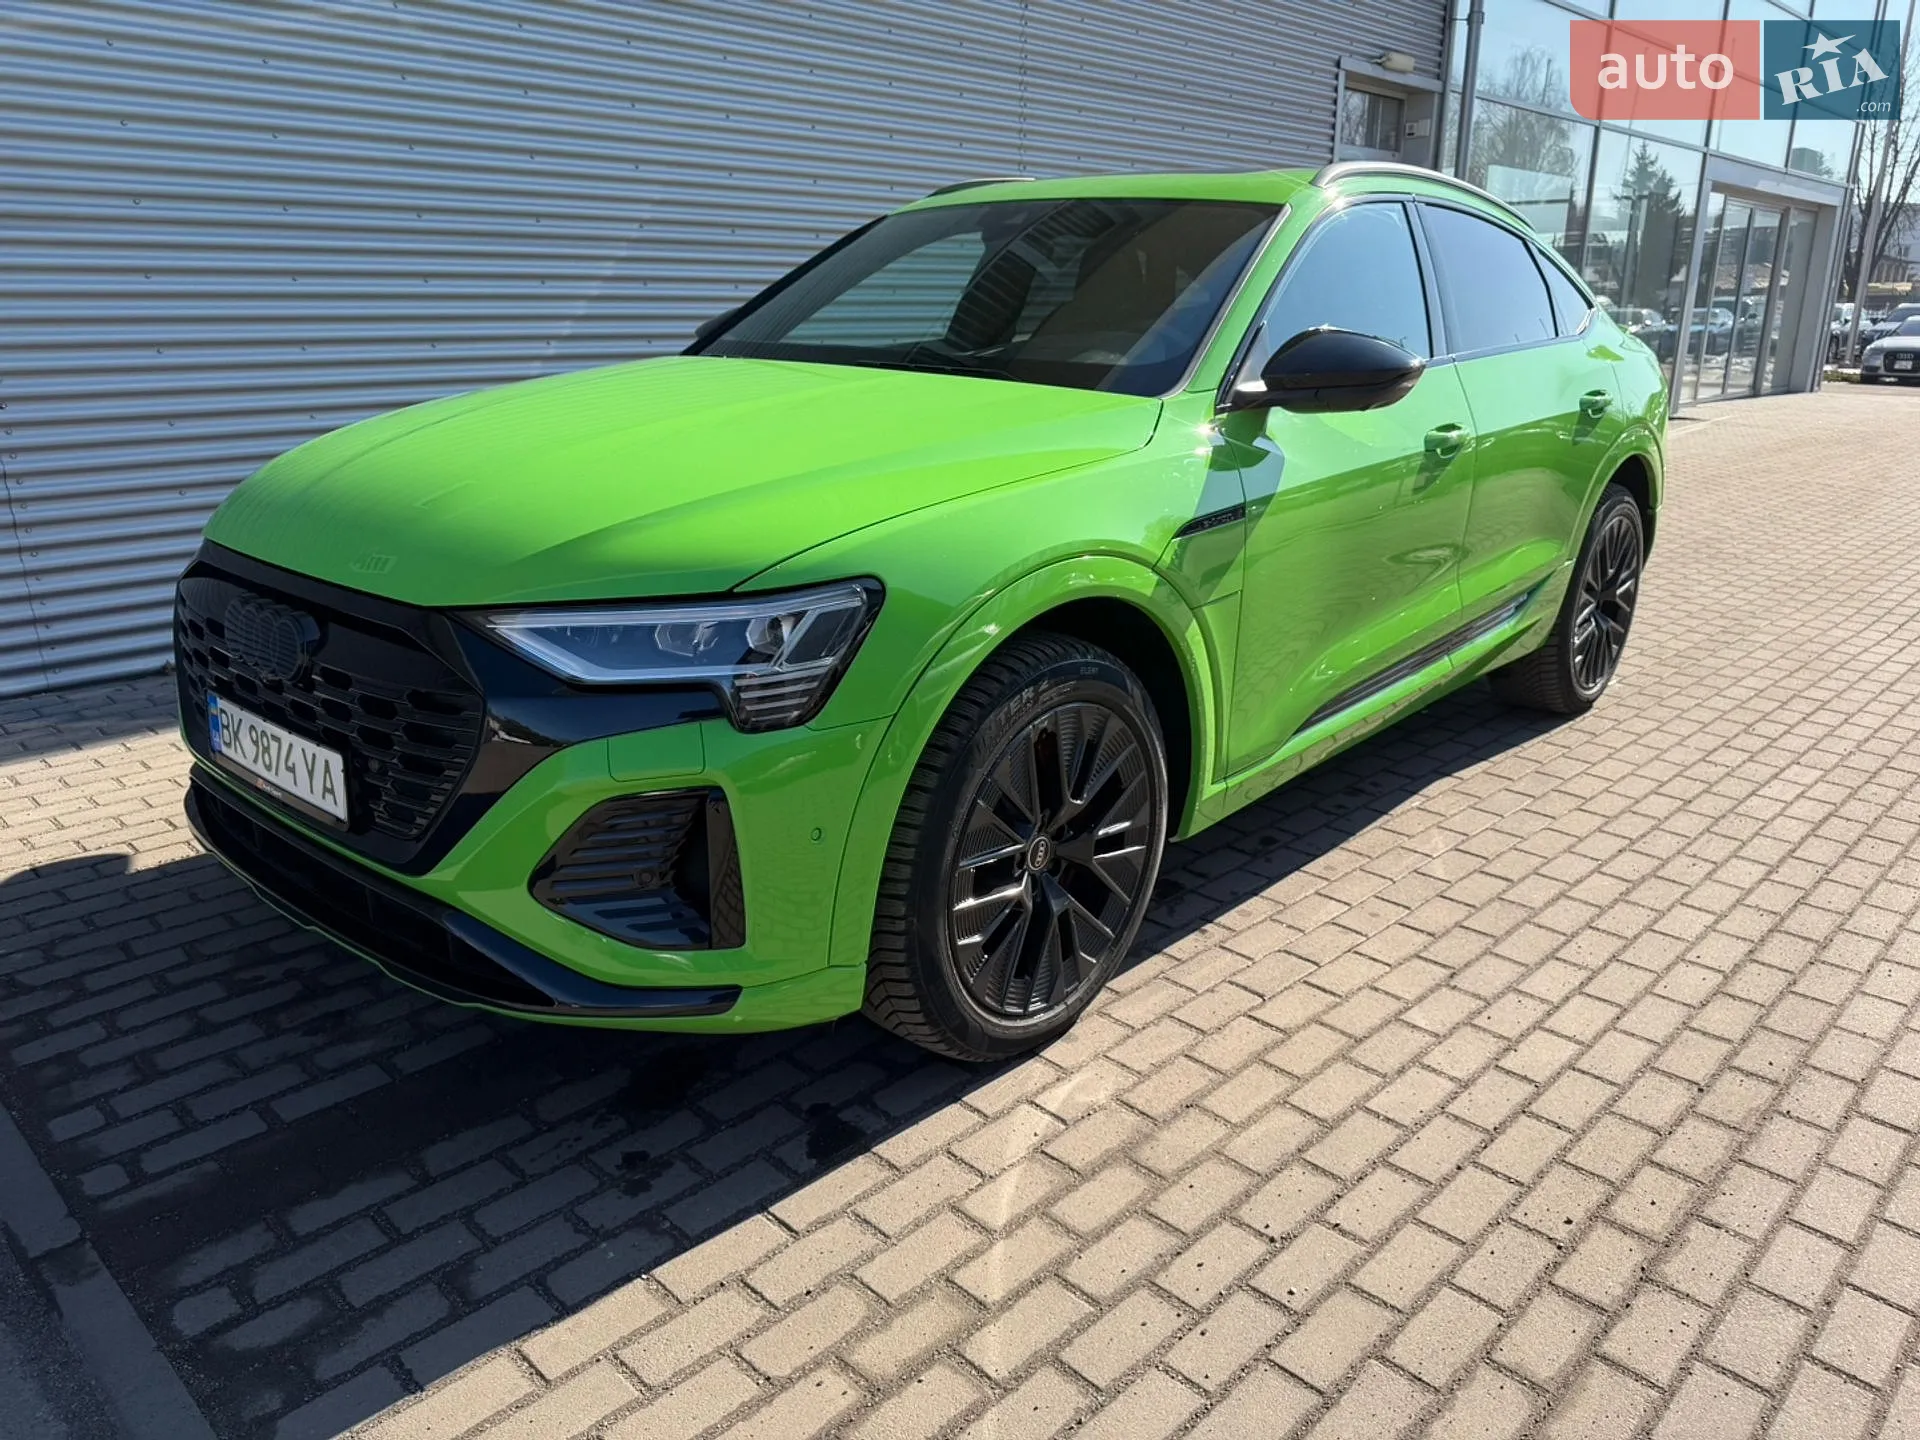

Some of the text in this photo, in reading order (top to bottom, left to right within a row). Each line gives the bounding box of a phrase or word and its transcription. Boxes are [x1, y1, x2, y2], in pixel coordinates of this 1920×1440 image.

[219, 707, 338, 807] BK 9874 YA
